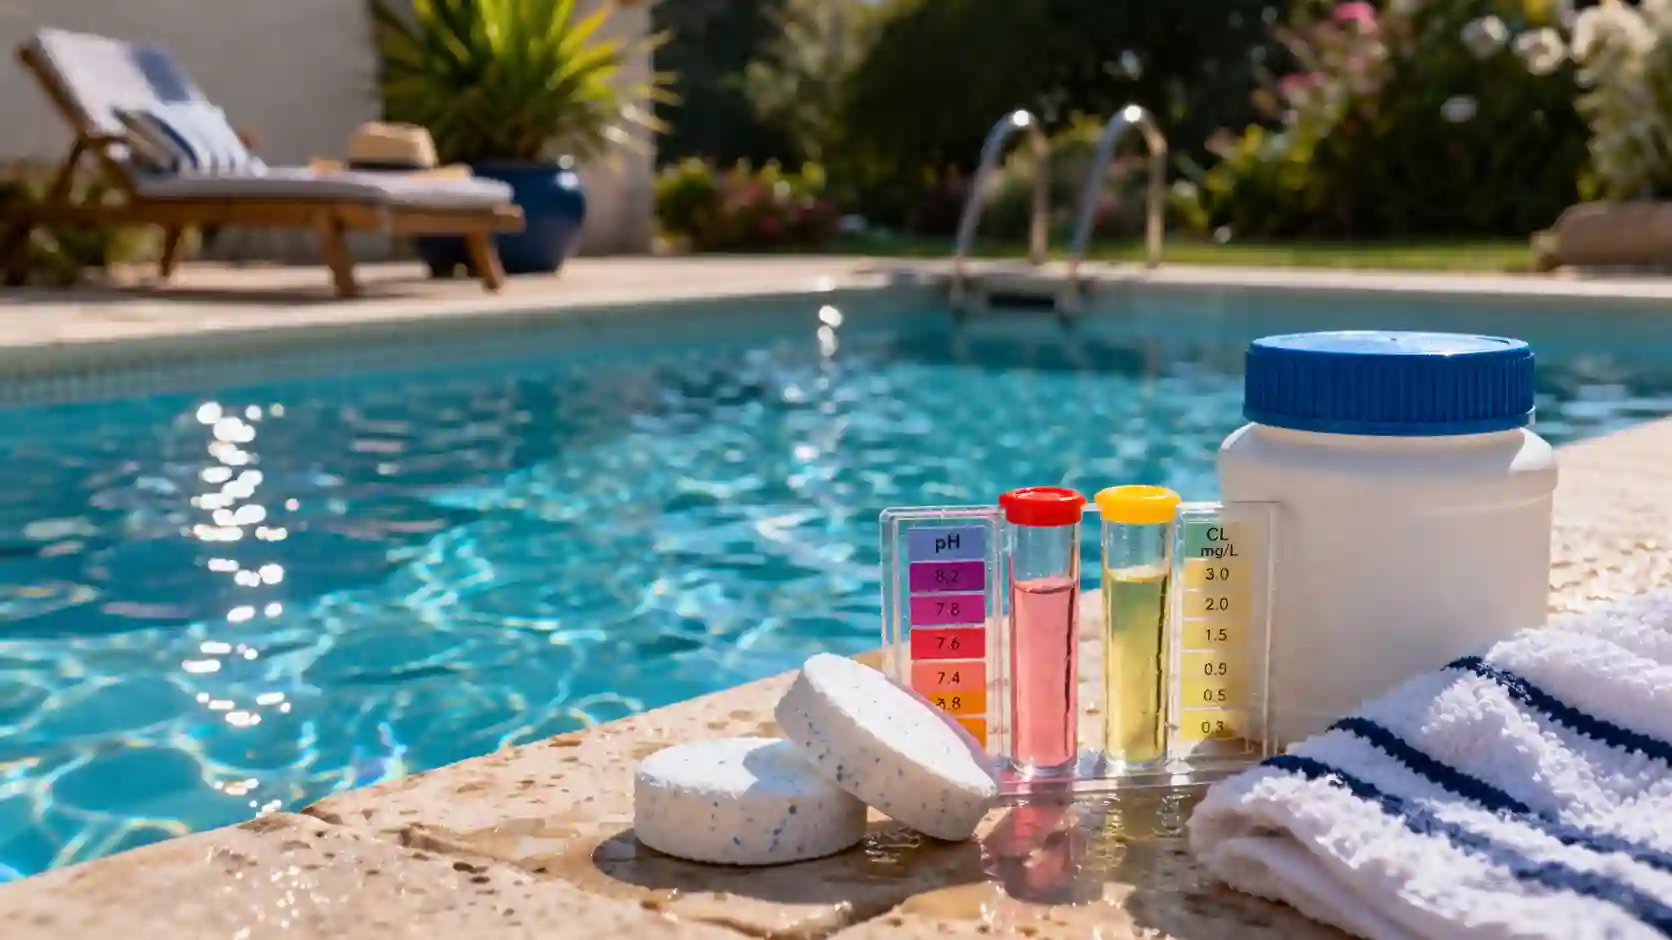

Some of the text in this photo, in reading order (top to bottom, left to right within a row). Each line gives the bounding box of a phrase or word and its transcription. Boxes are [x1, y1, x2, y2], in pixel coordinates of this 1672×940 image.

[935, 533, 960, 554] pH
[1200, 543, 1239, 559] mg/L
[1205, 567, 1230, 581] 3.0
[1205, 596, 1229, 611] 2.0
[1206, 628, 1227, 641] 1.5
[936, 636, 961, 650] 7.6
[1204, 662, 1227, 676] 0.9
[938, 670, 960, 685] 7.4
